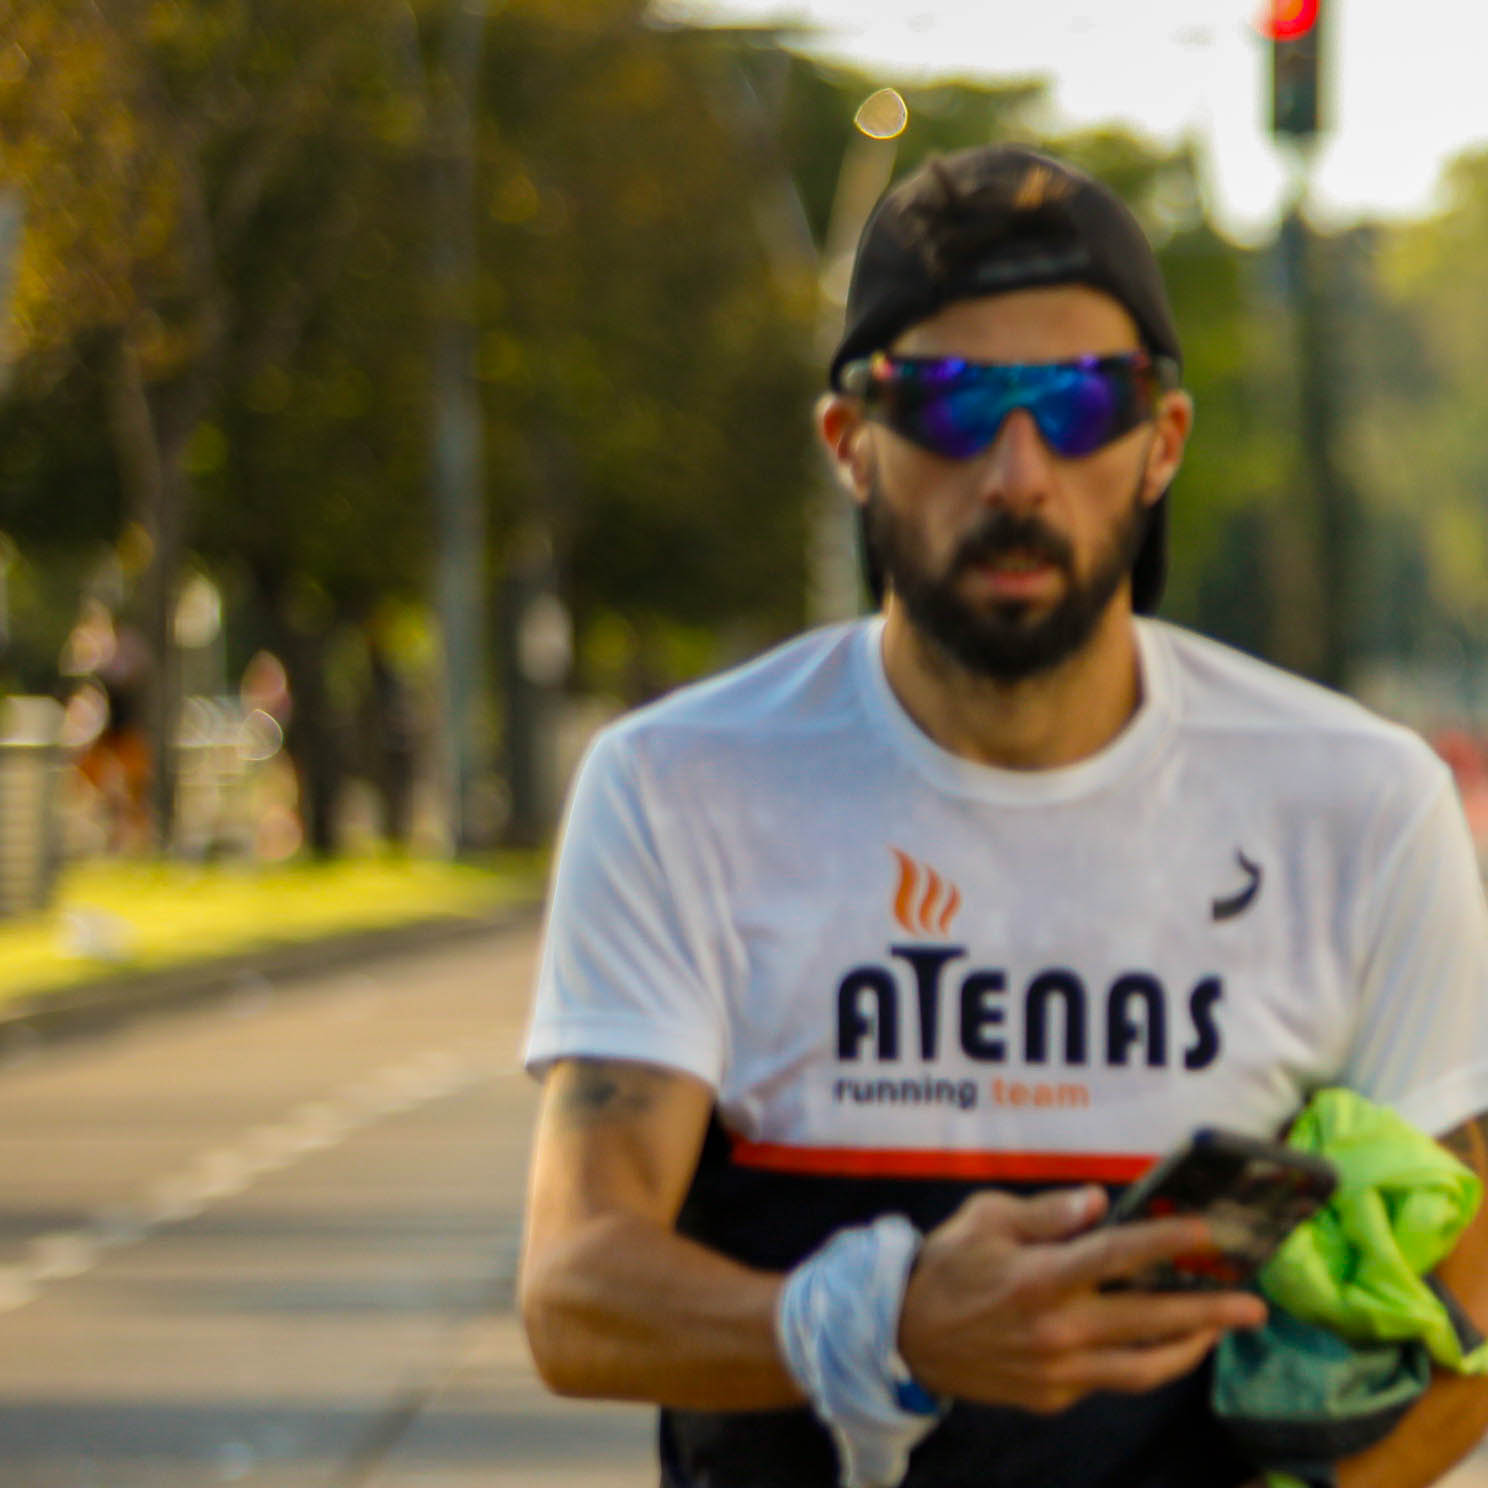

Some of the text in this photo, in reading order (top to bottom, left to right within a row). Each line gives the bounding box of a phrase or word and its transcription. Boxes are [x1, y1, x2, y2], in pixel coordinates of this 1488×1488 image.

[836, 945, 1224, 1071] ATENAS
[834, 1076, 1092, 1110] running team
